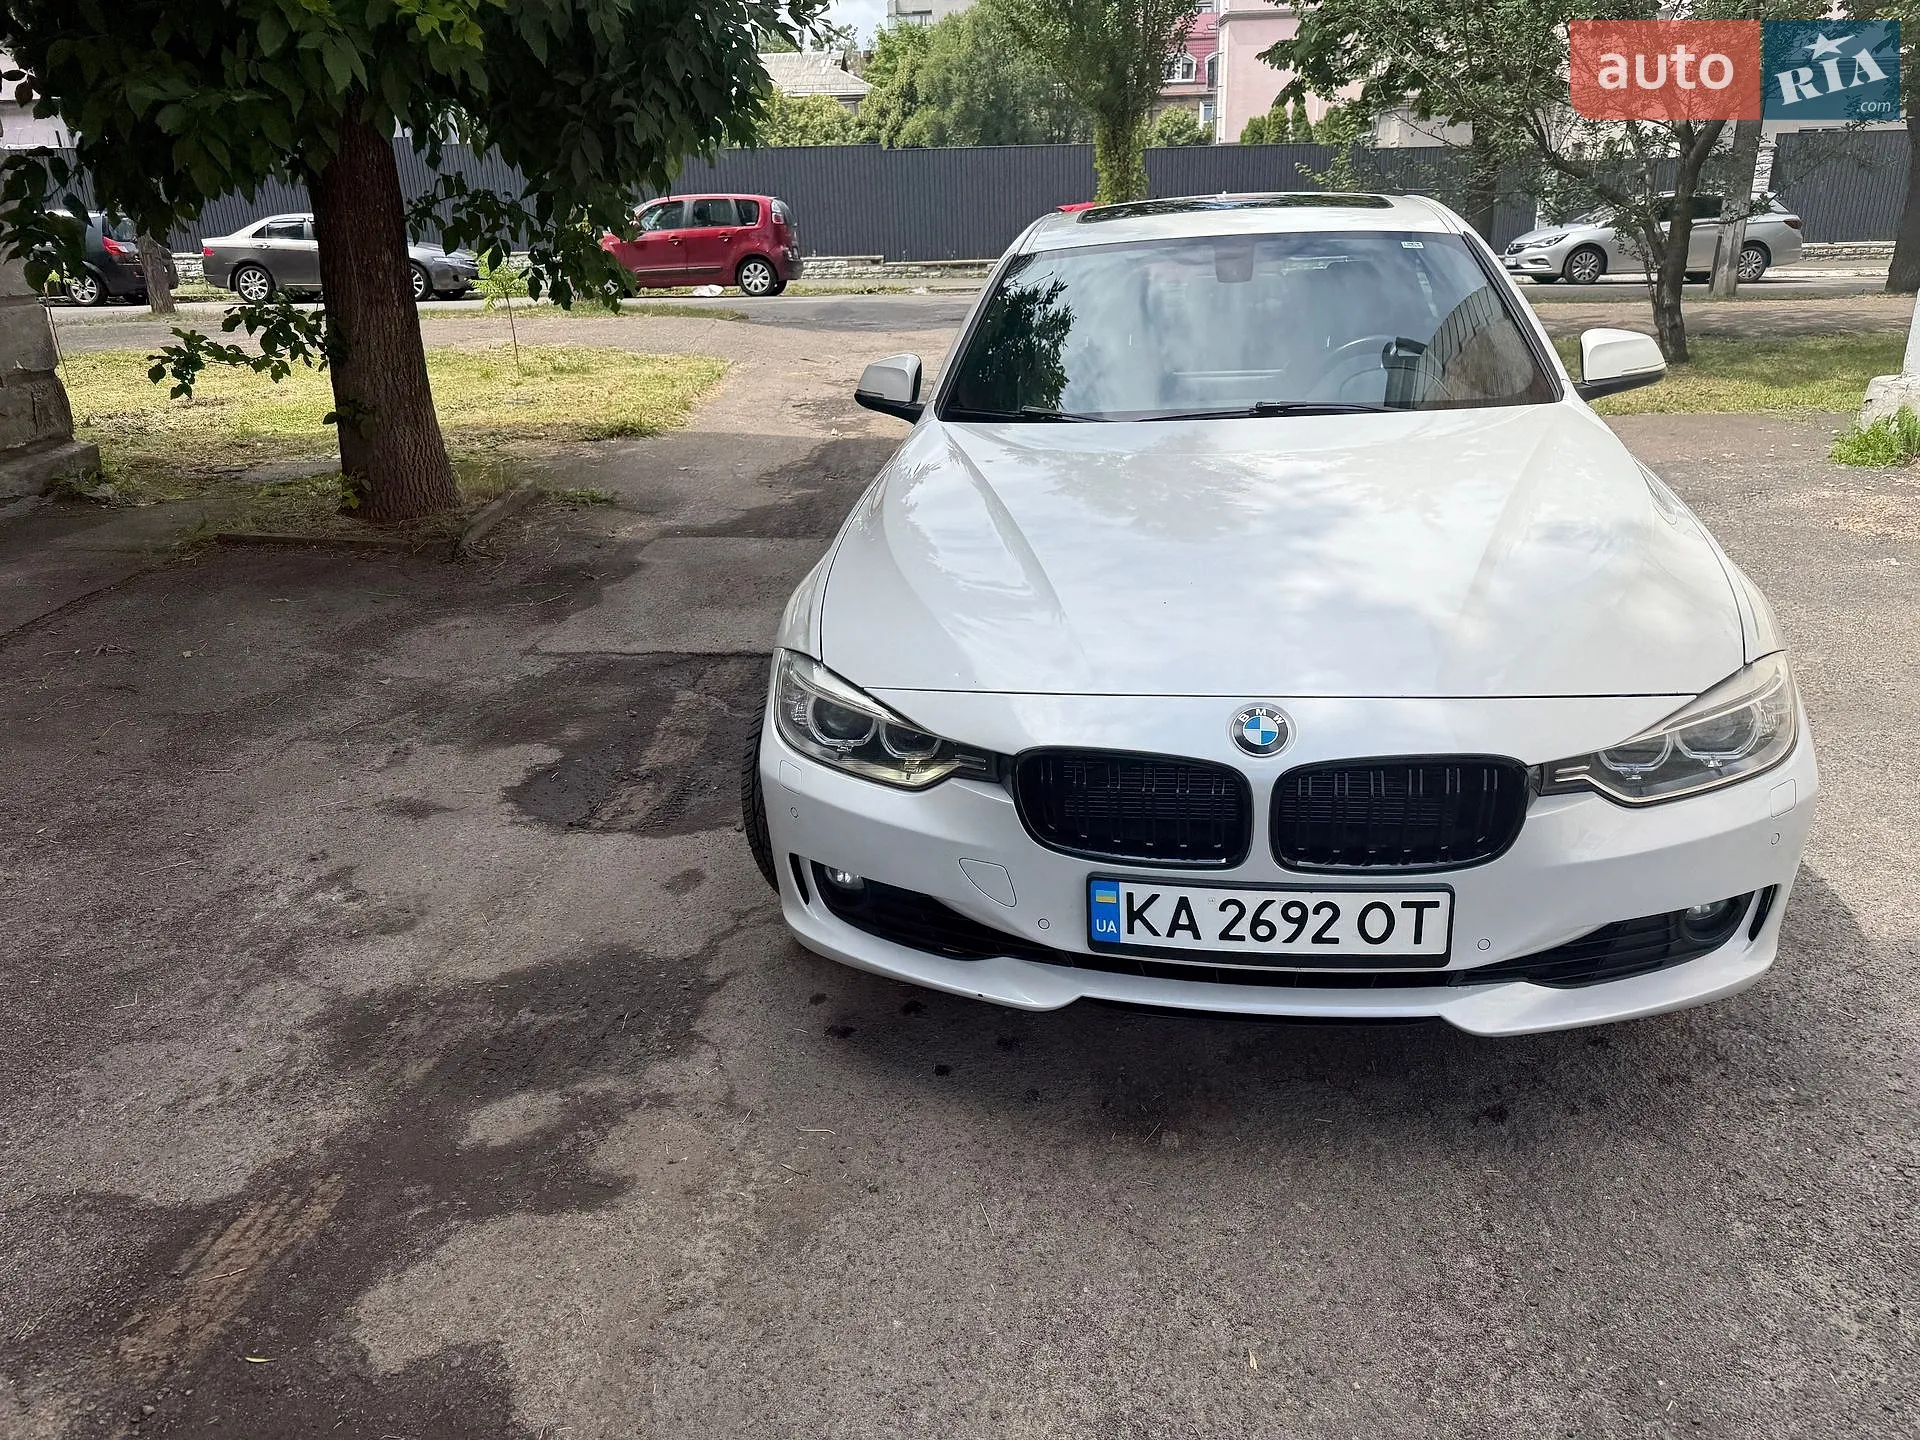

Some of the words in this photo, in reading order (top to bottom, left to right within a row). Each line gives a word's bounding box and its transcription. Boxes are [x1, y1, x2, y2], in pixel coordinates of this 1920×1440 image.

[1238, 708, 1284, 724] BMW
[1125, 891, 1202, 941] KA
[1218, 898, 1341, 945] 2692
[1357, 900, 1441, 945] OT
[1096, 919, 1117, 934] UA
